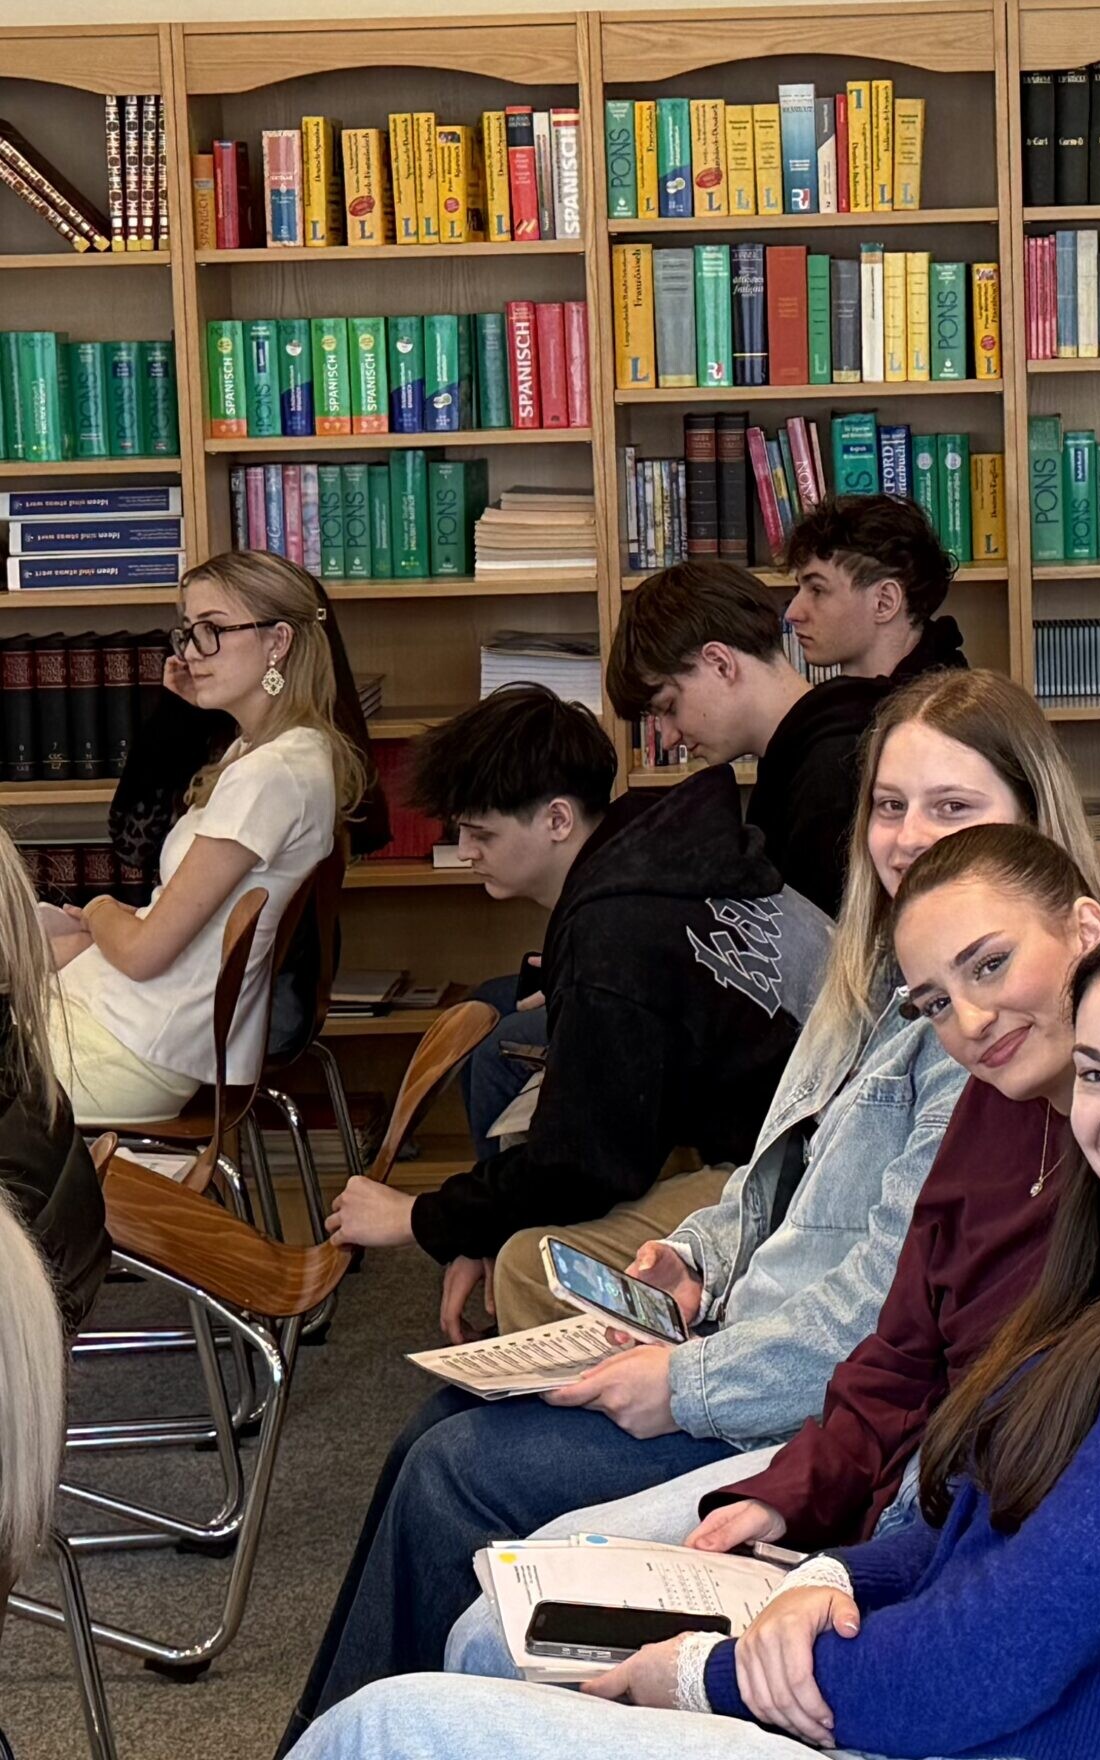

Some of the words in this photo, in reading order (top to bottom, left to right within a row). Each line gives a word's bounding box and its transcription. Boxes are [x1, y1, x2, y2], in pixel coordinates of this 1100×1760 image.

[560, 128, 580, 234] SPANISCH
[608, 128, 631, 188] PONS
[359, 220, 373, 239] L
[705, 192, 721, 211] L
[311, 220, 325, 241] L
[937, 291, 958, 350] PONS
[223, 357, 236, 415] SPANISCH
[327, 355, 339, 411] SPANISCH
[365, 353, 377, 411] SPANISCH
[516, 322, 533, 418] SPANISCH
[630, 357, 649, 382] L
[256, 384, 271, 428] PONS
[882, 445, 895, 494] XFORD
[896, 444, 906, 498] örterbuch
[1034, 458, 1059, 524] PONS
[322, 492, 341, 549] PONS
[346, 491, 367, 548] PONS
[437, 489, 457, 546] PONS
[985, 534, 998, 554] L
[1073, 499, 1090, 547] PONS
[78, 568, 95, 576] sind
